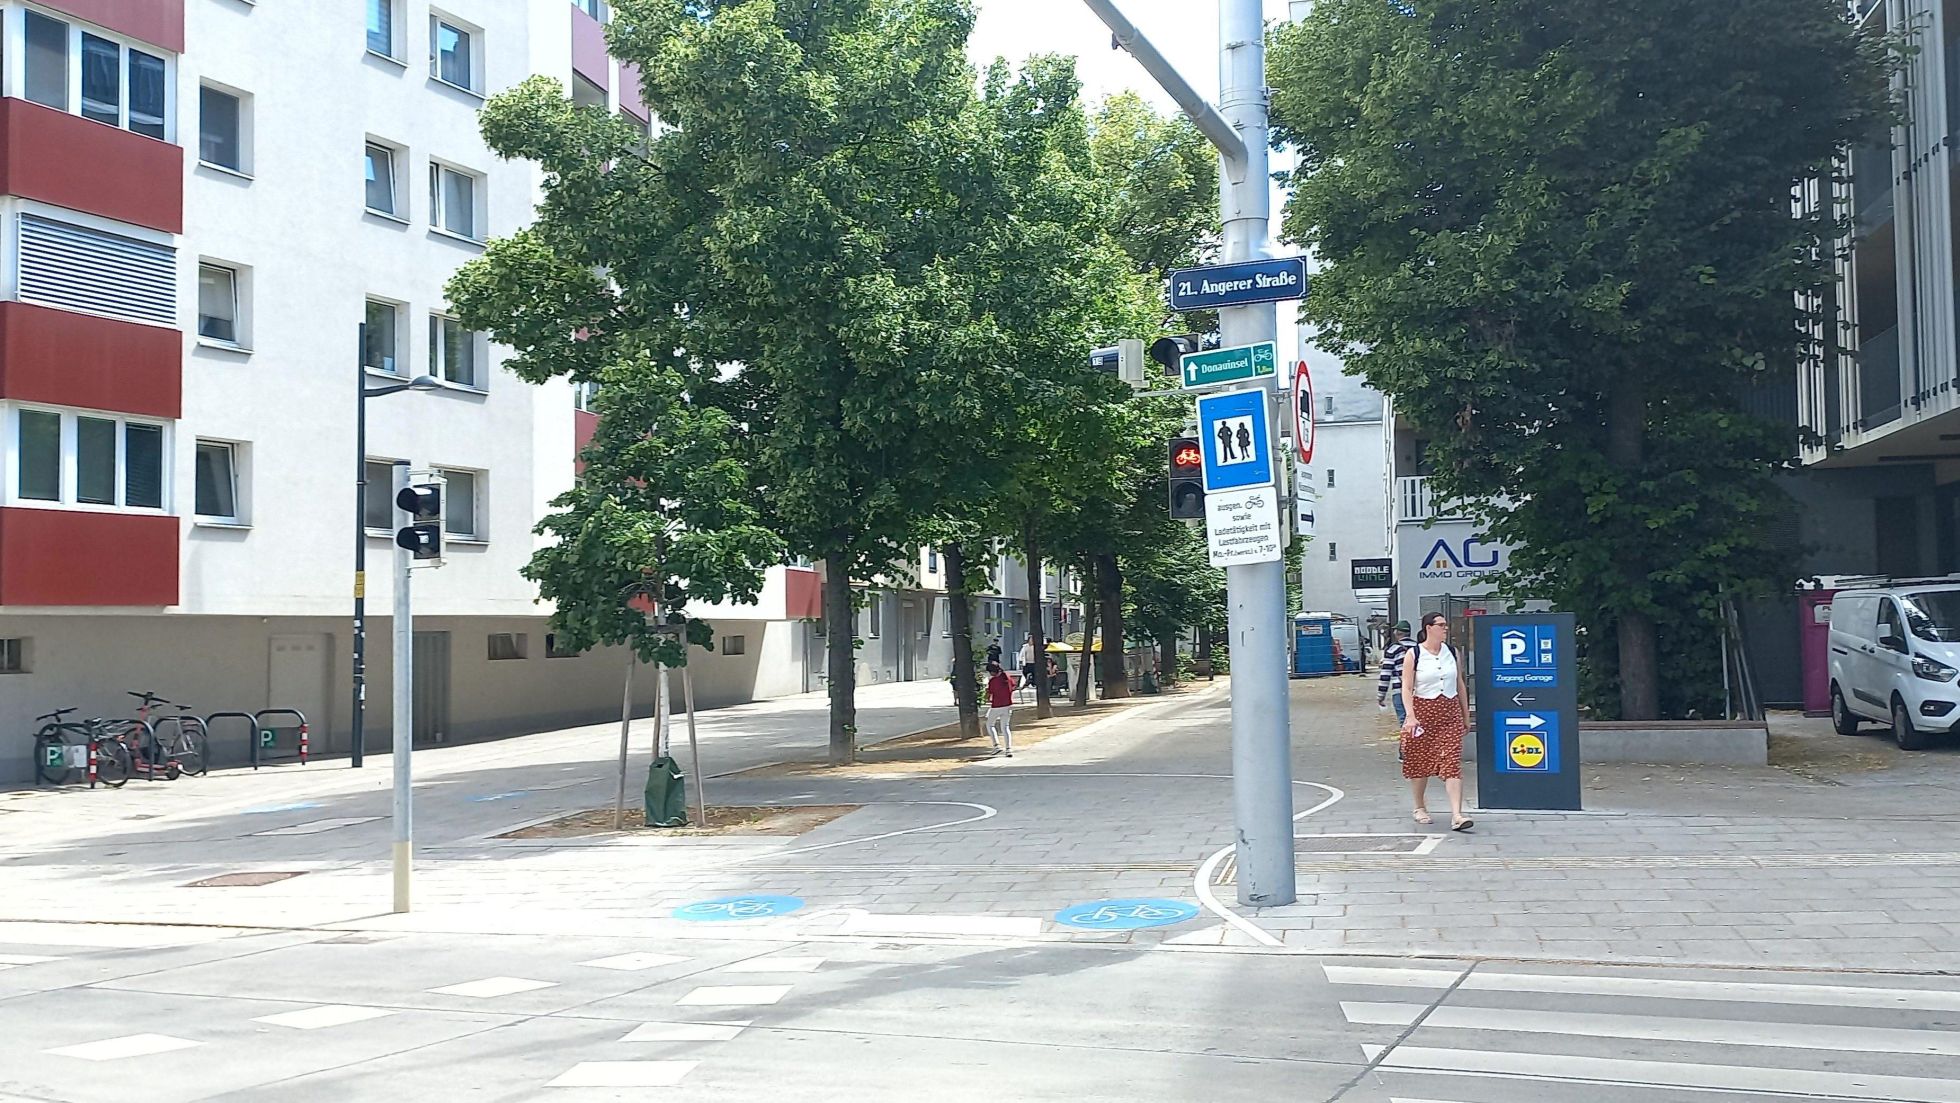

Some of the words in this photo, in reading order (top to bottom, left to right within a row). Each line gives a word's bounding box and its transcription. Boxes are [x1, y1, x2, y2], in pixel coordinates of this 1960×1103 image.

[1178, 281, 1198, 297] 21.
[1200, 278, 1253, 296] Angerer
[1255, 271, 1297, 288] Straße
[1201, 357, 1249, 374] Donauinsel
[1232, 512, 1252, 521] sowie
[1214, 523, 1258, 536] Ladetätigkeit
[1259, 522, 1271, 531] mit
[1218, 535, 1269, 547] Lastfahrzeugen
[1420, 538, 1499, 569] AG
[1354, 566, 1390, 575] NOODLE
[1419, 571, 1452, 579] IMMO
[1456, 569, 1500, 578] GROUP
[1501, 637, 1526, 665] P
[1495, 674, 1524, 683] Zugang
[1524, 673, 1554, 683] Garage
[260, 730, 273, 747] P
